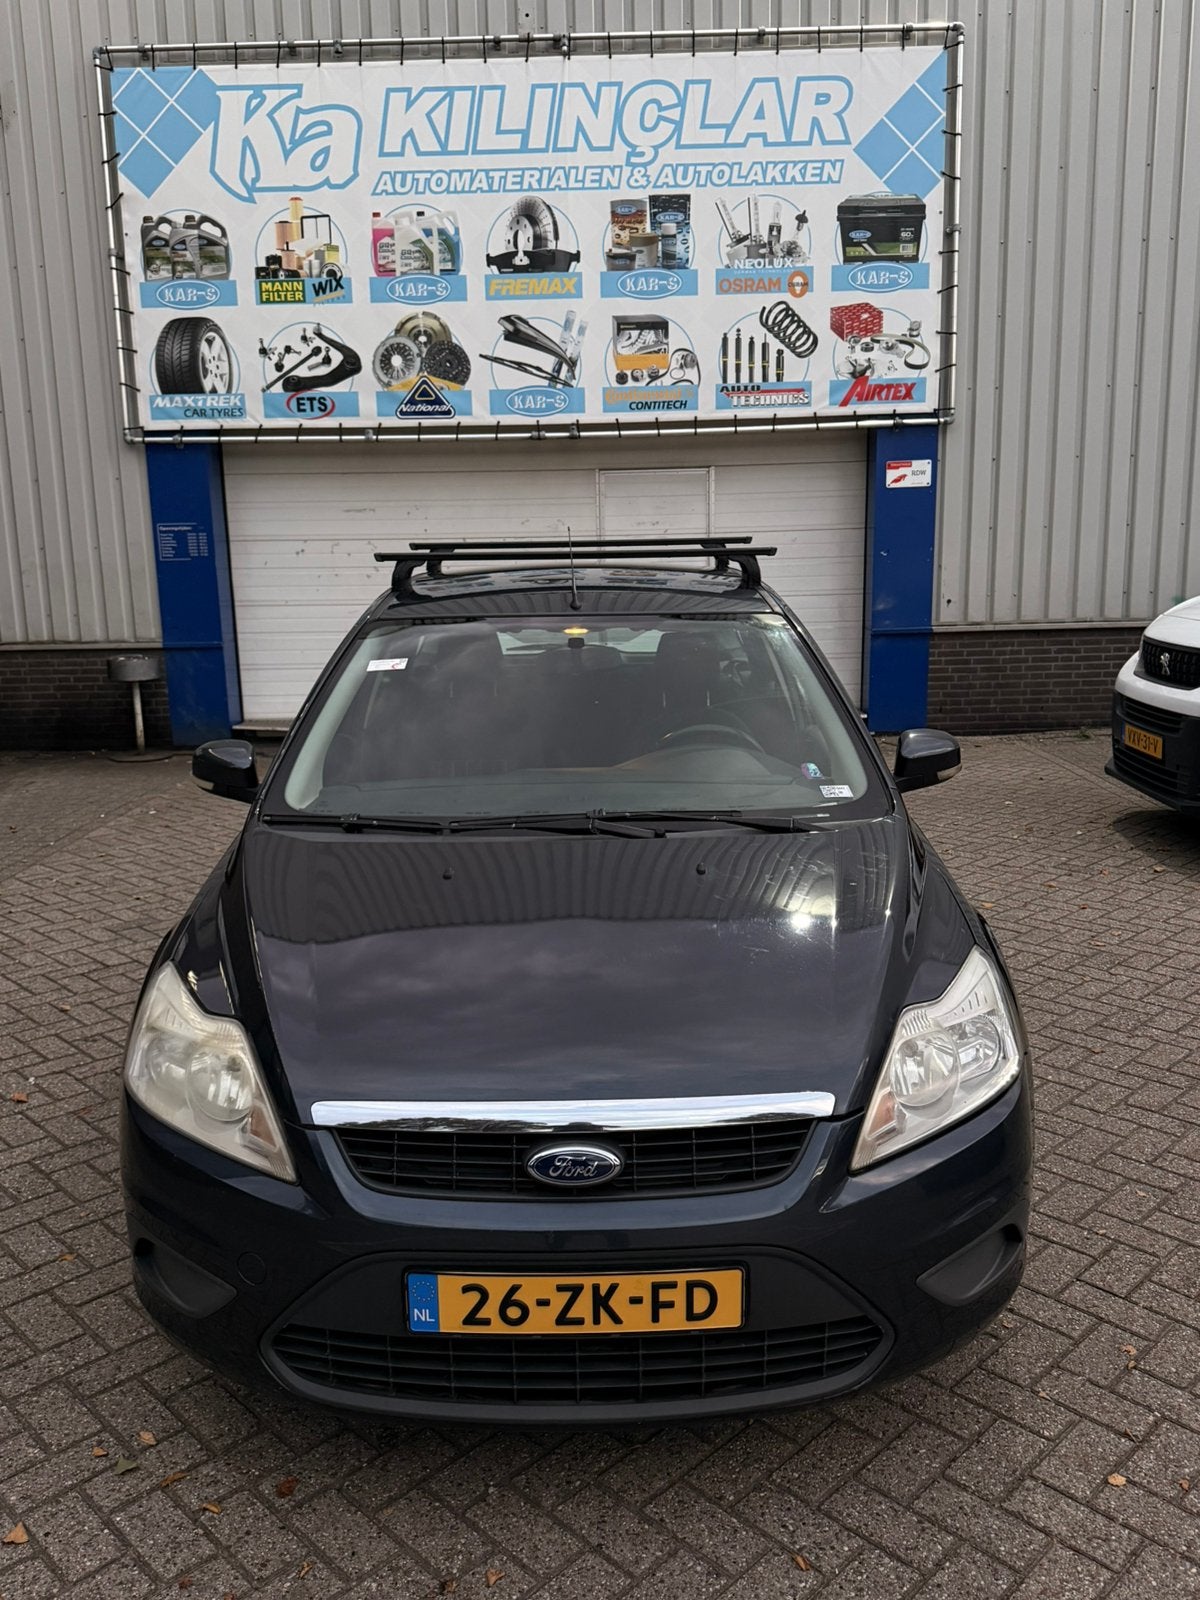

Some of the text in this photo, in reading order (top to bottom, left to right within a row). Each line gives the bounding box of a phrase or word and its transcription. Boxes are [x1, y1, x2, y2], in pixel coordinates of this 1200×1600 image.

[378, 75, 854, 167] KILINÇLAR
[371, 158, 845, 196] AUTOMATERIALEN & AUTOLAKKEN
[734, 257, 794, 270] NEOLUX
[625, 276, 678, 292] KAR-S
[719, 276, 782, 294] OSRAM
[856, 270, 909, 285] KAR-S
[262, 281, 303, 292] MANN
[312, 275, 345, 297] WIX
[394, 282, 447, 297] KAR-S
[489, 277, 577, 296] FREMAX
[164, 287, 217, 301] KAR-S
[262, 291, 303, 302] FILTER
[719, 384, 761, 392] AUTO
[839, 375, 917, 408] AIRTEX
[152, 394, 243, 408] MAXTREK
[296, 396, 329, 413] ETS
[400, 402, 451, 413] National
[513, 395, 565, 409] KAR-S
[629, 400, 688, 411] CONTITECH
[731, 393, 809, 408] TECHNICS
[184, 407, 244, 418] CAR TYRES
[549, 1155, 598, 1178] Ford
[461, 1280, 718, 1326] 26-ZK-FD
[414, 1308, 435, 1322] NL
